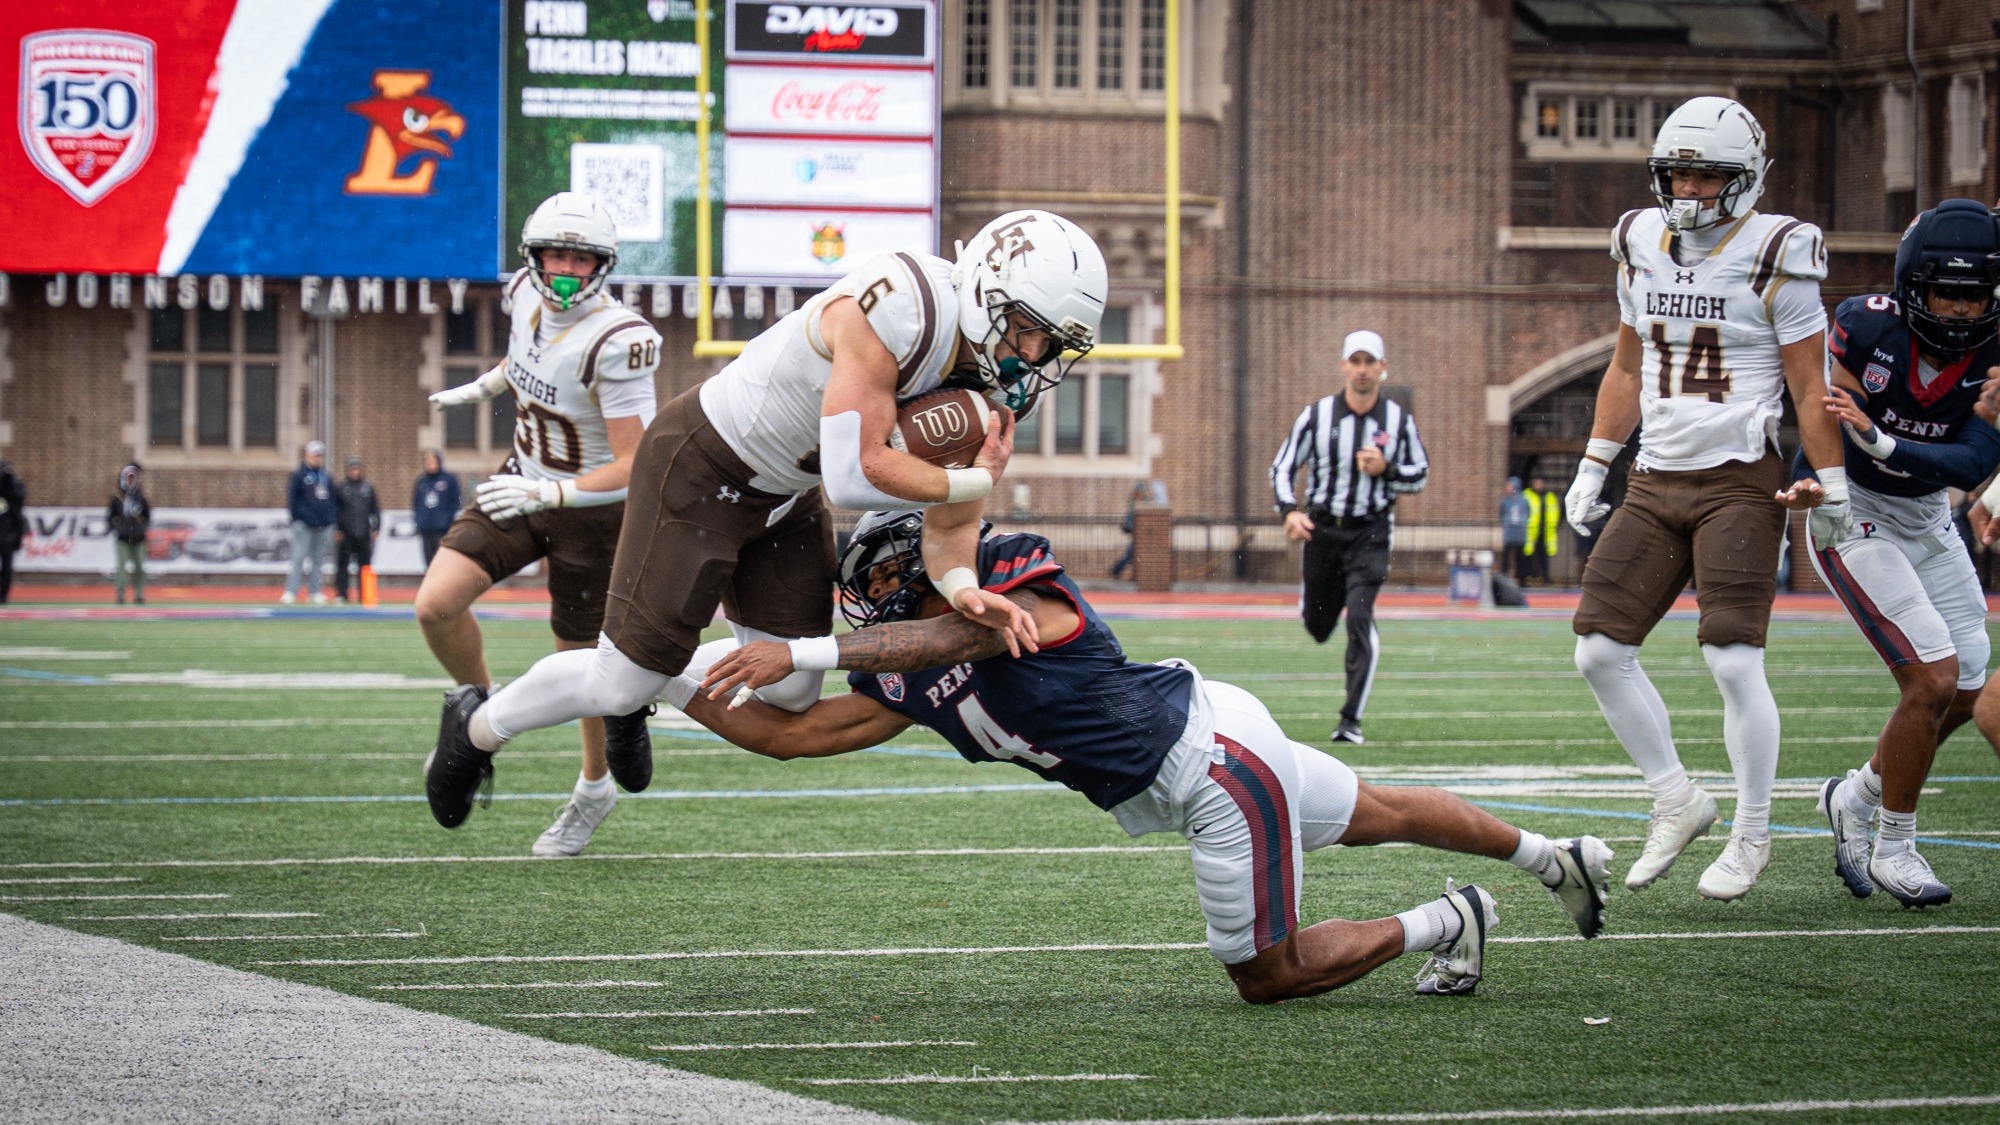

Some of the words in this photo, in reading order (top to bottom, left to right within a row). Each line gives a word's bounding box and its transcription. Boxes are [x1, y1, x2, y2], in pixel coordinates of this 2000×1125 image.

[525, 0, 587, 36] PENN
[765, 5, 898, 36] DAVID
[526, 38, 625, 76] TACKLES
[37, 79, 139, 131] 150
[46, 272, 263, 311] JOHNSON
[302, 276, 468, 315] FAMILY
[857, 277, 895, 316] 6
[1646, 292, 1727, 321] LEHIGH
[628, 339, 656, 370] 80
[1650, 321, 1734, 404] 14
[1874, 348, 1888, 361] Ivy
[1866, 370, 1886, 386] 150
[1881, 407, 1950, 437] PENN
[956, 691, 1063, 769] 4
